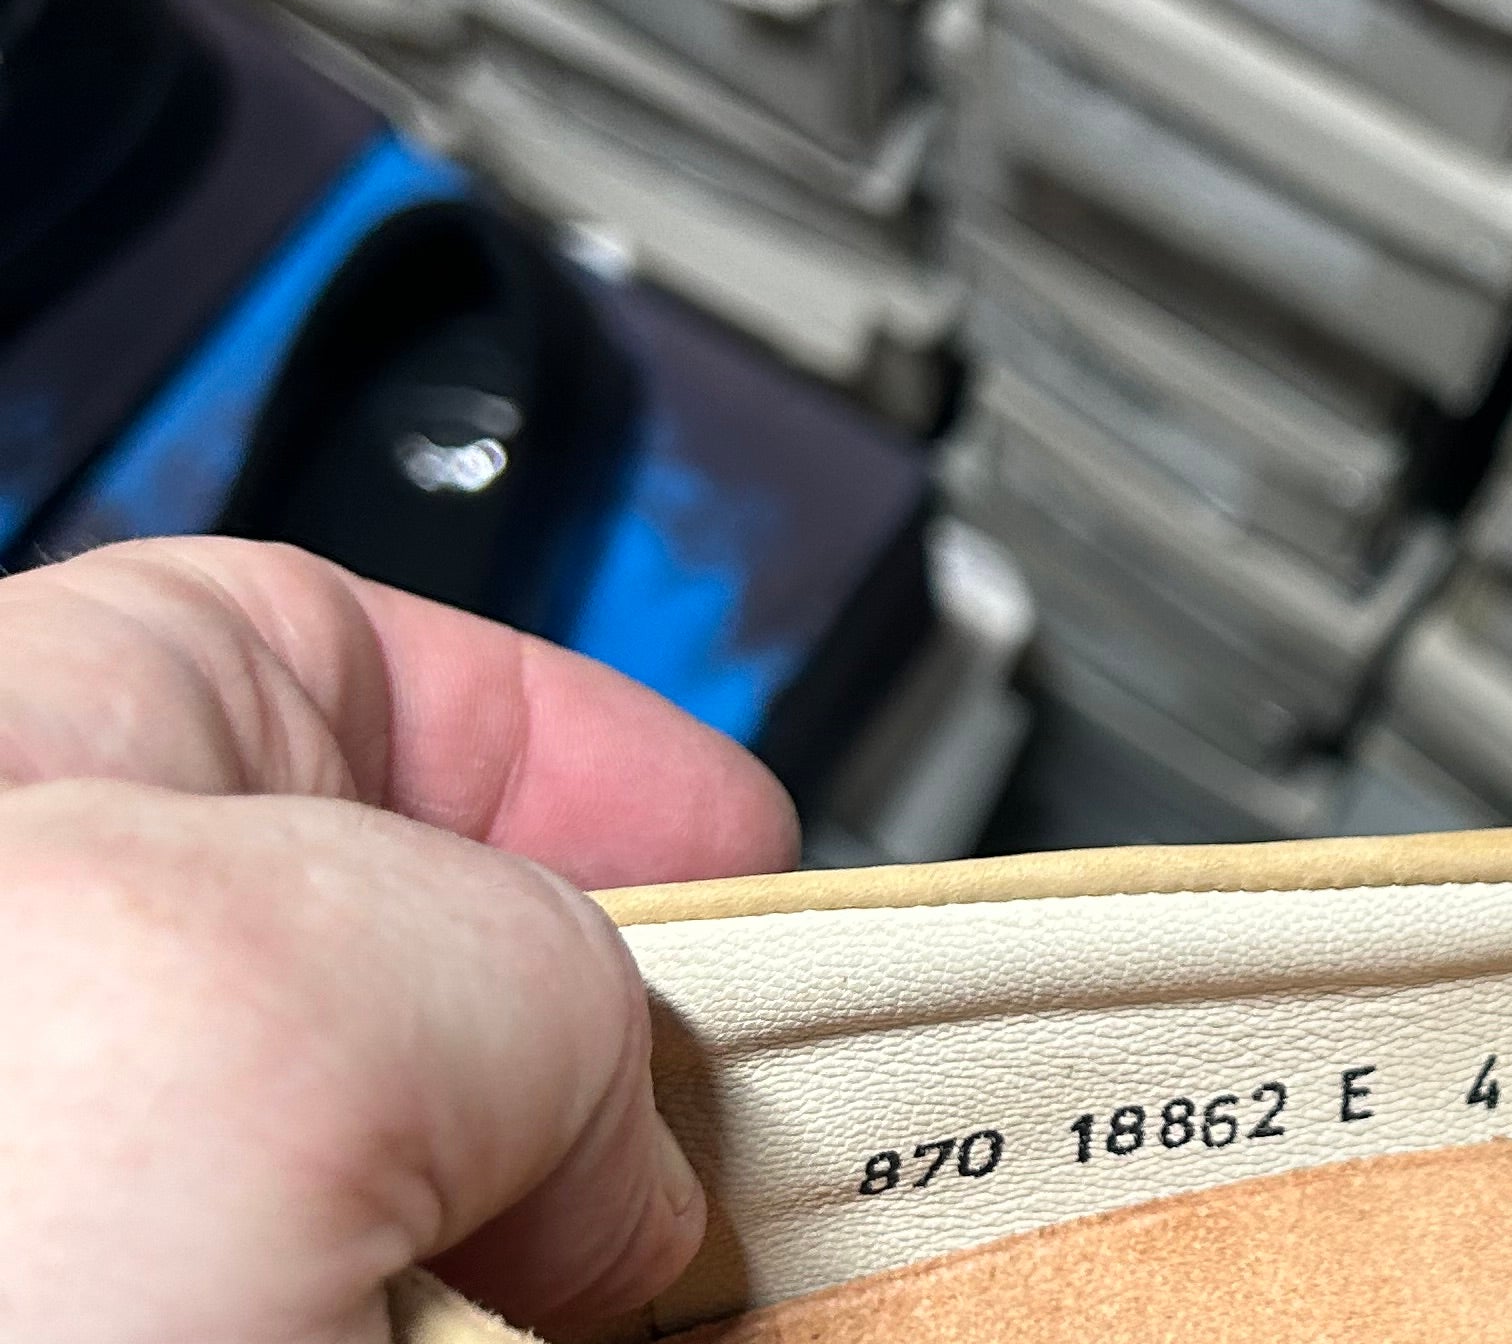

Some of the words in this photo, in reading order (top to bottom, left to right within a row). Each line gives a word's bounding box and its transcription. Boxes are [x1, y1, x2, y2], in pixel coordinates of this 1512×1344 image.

[858, 1129, 1005, 1196] 870
[1070, 1082, 1288, 1164] 18862
[1340, 1065, 1377, 1123] E
[1466, 1054, 1500, 1110] 4
